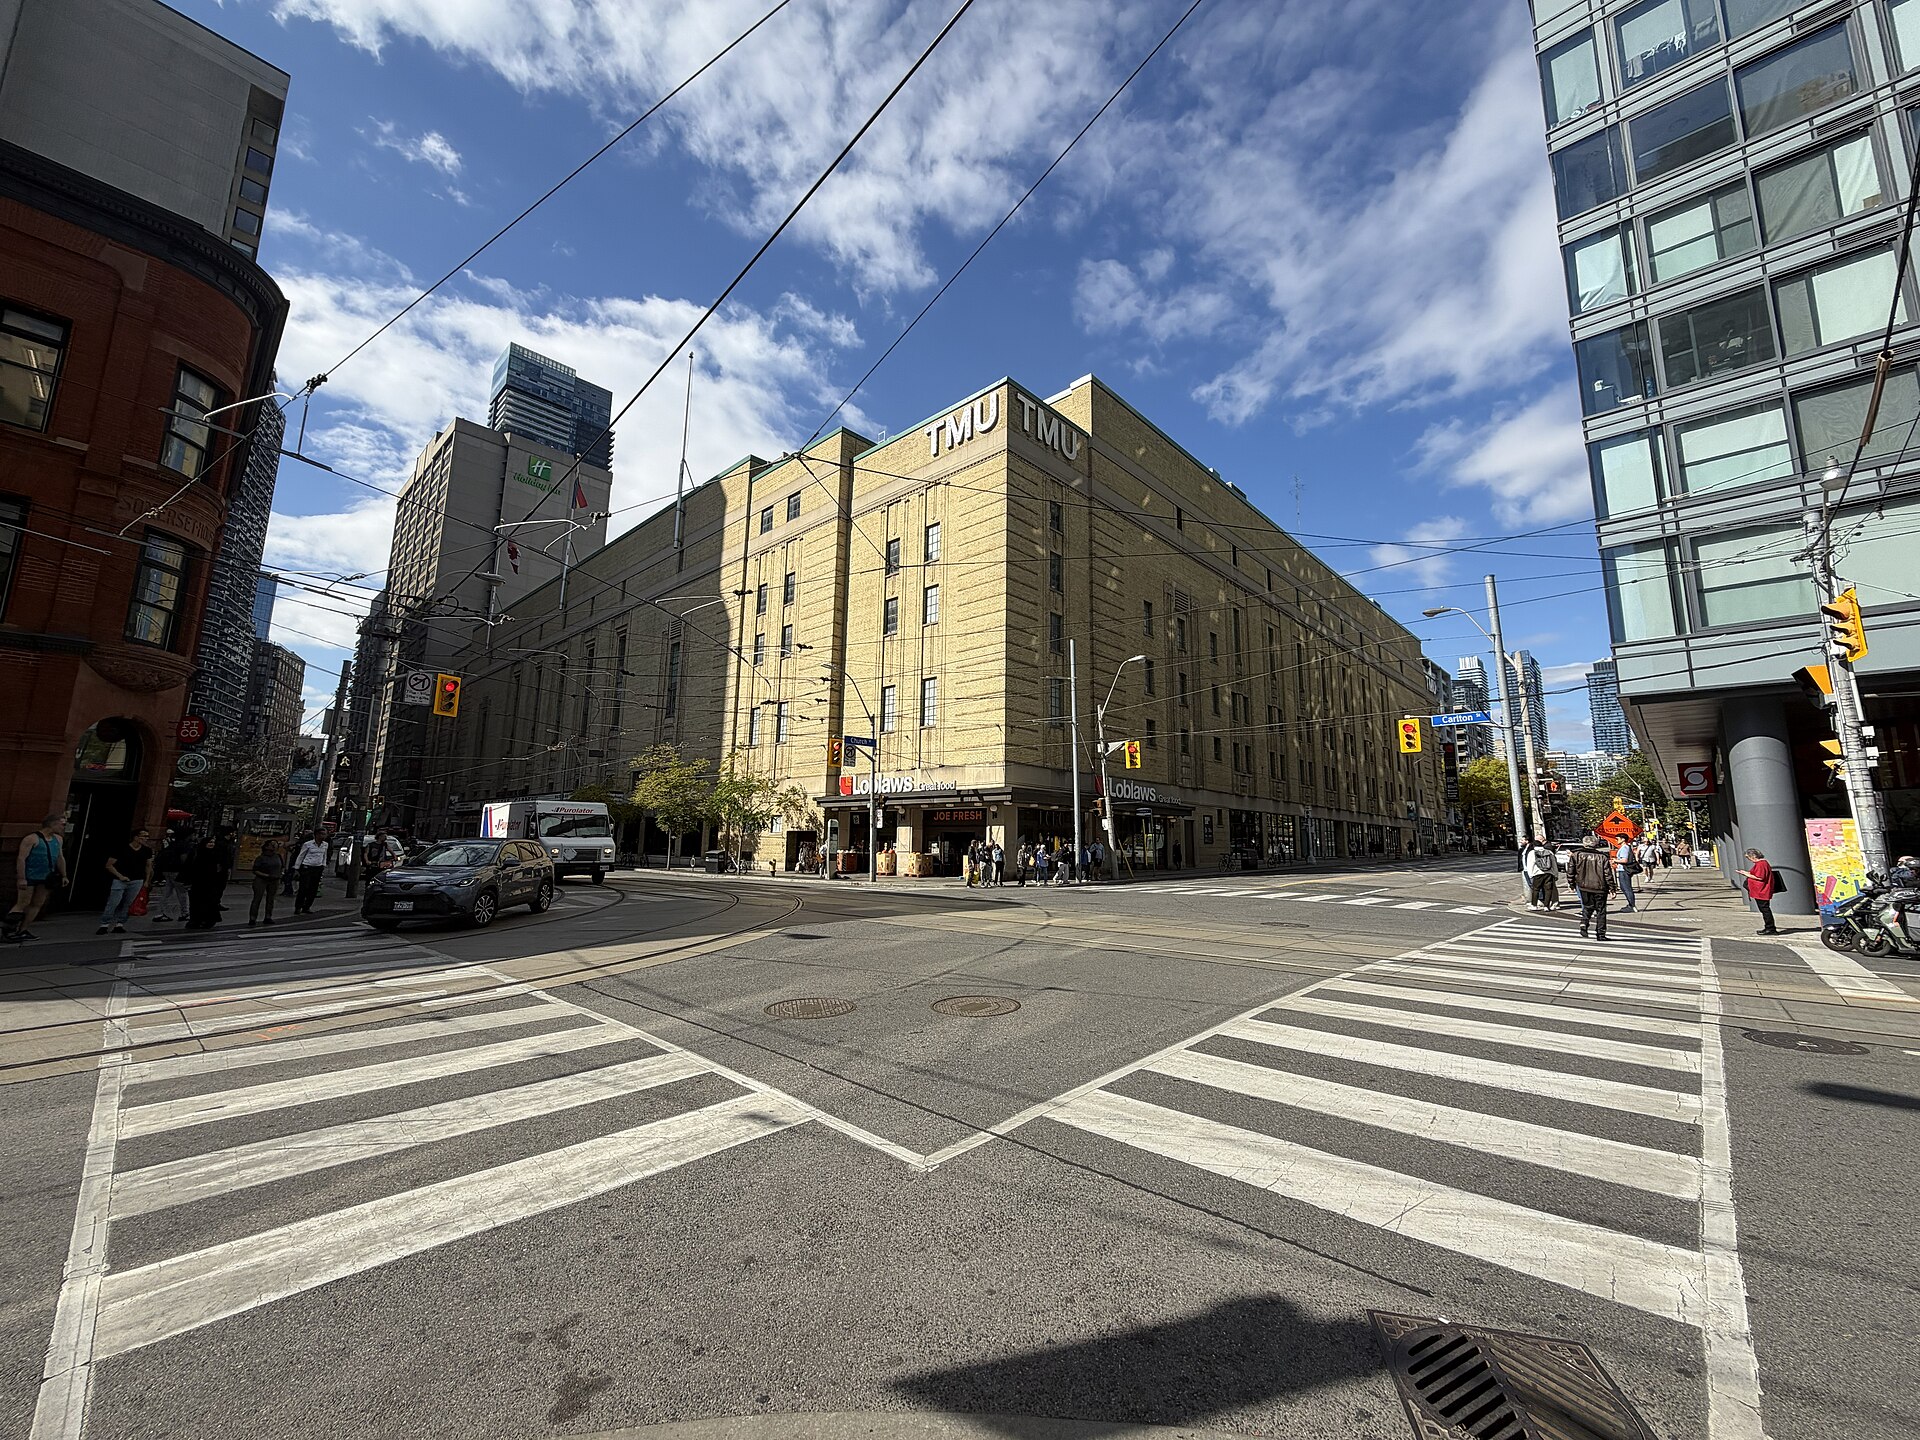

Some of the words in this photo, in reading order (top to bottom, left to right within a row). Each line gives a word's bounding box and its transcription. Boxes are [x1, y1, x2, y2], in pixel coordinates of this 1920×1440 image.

[924, 391, 999, 457] TMU
[1016, 392, 1079, 461] TMU
[513, 472, 547, 491] Holiday
[181, 720, 200, 729] PI
[1441, 714, 1473, 724] Carlton
[850, 737, 868, 745] Church
[1108, 777, 1157, 802] Loblaws
[1158, 794, 1170, 804] Great
[1690, 800, 1701, 811] P
[933, 811, 951, 821] JOE
[953, 810, 983, 820] FRESH
